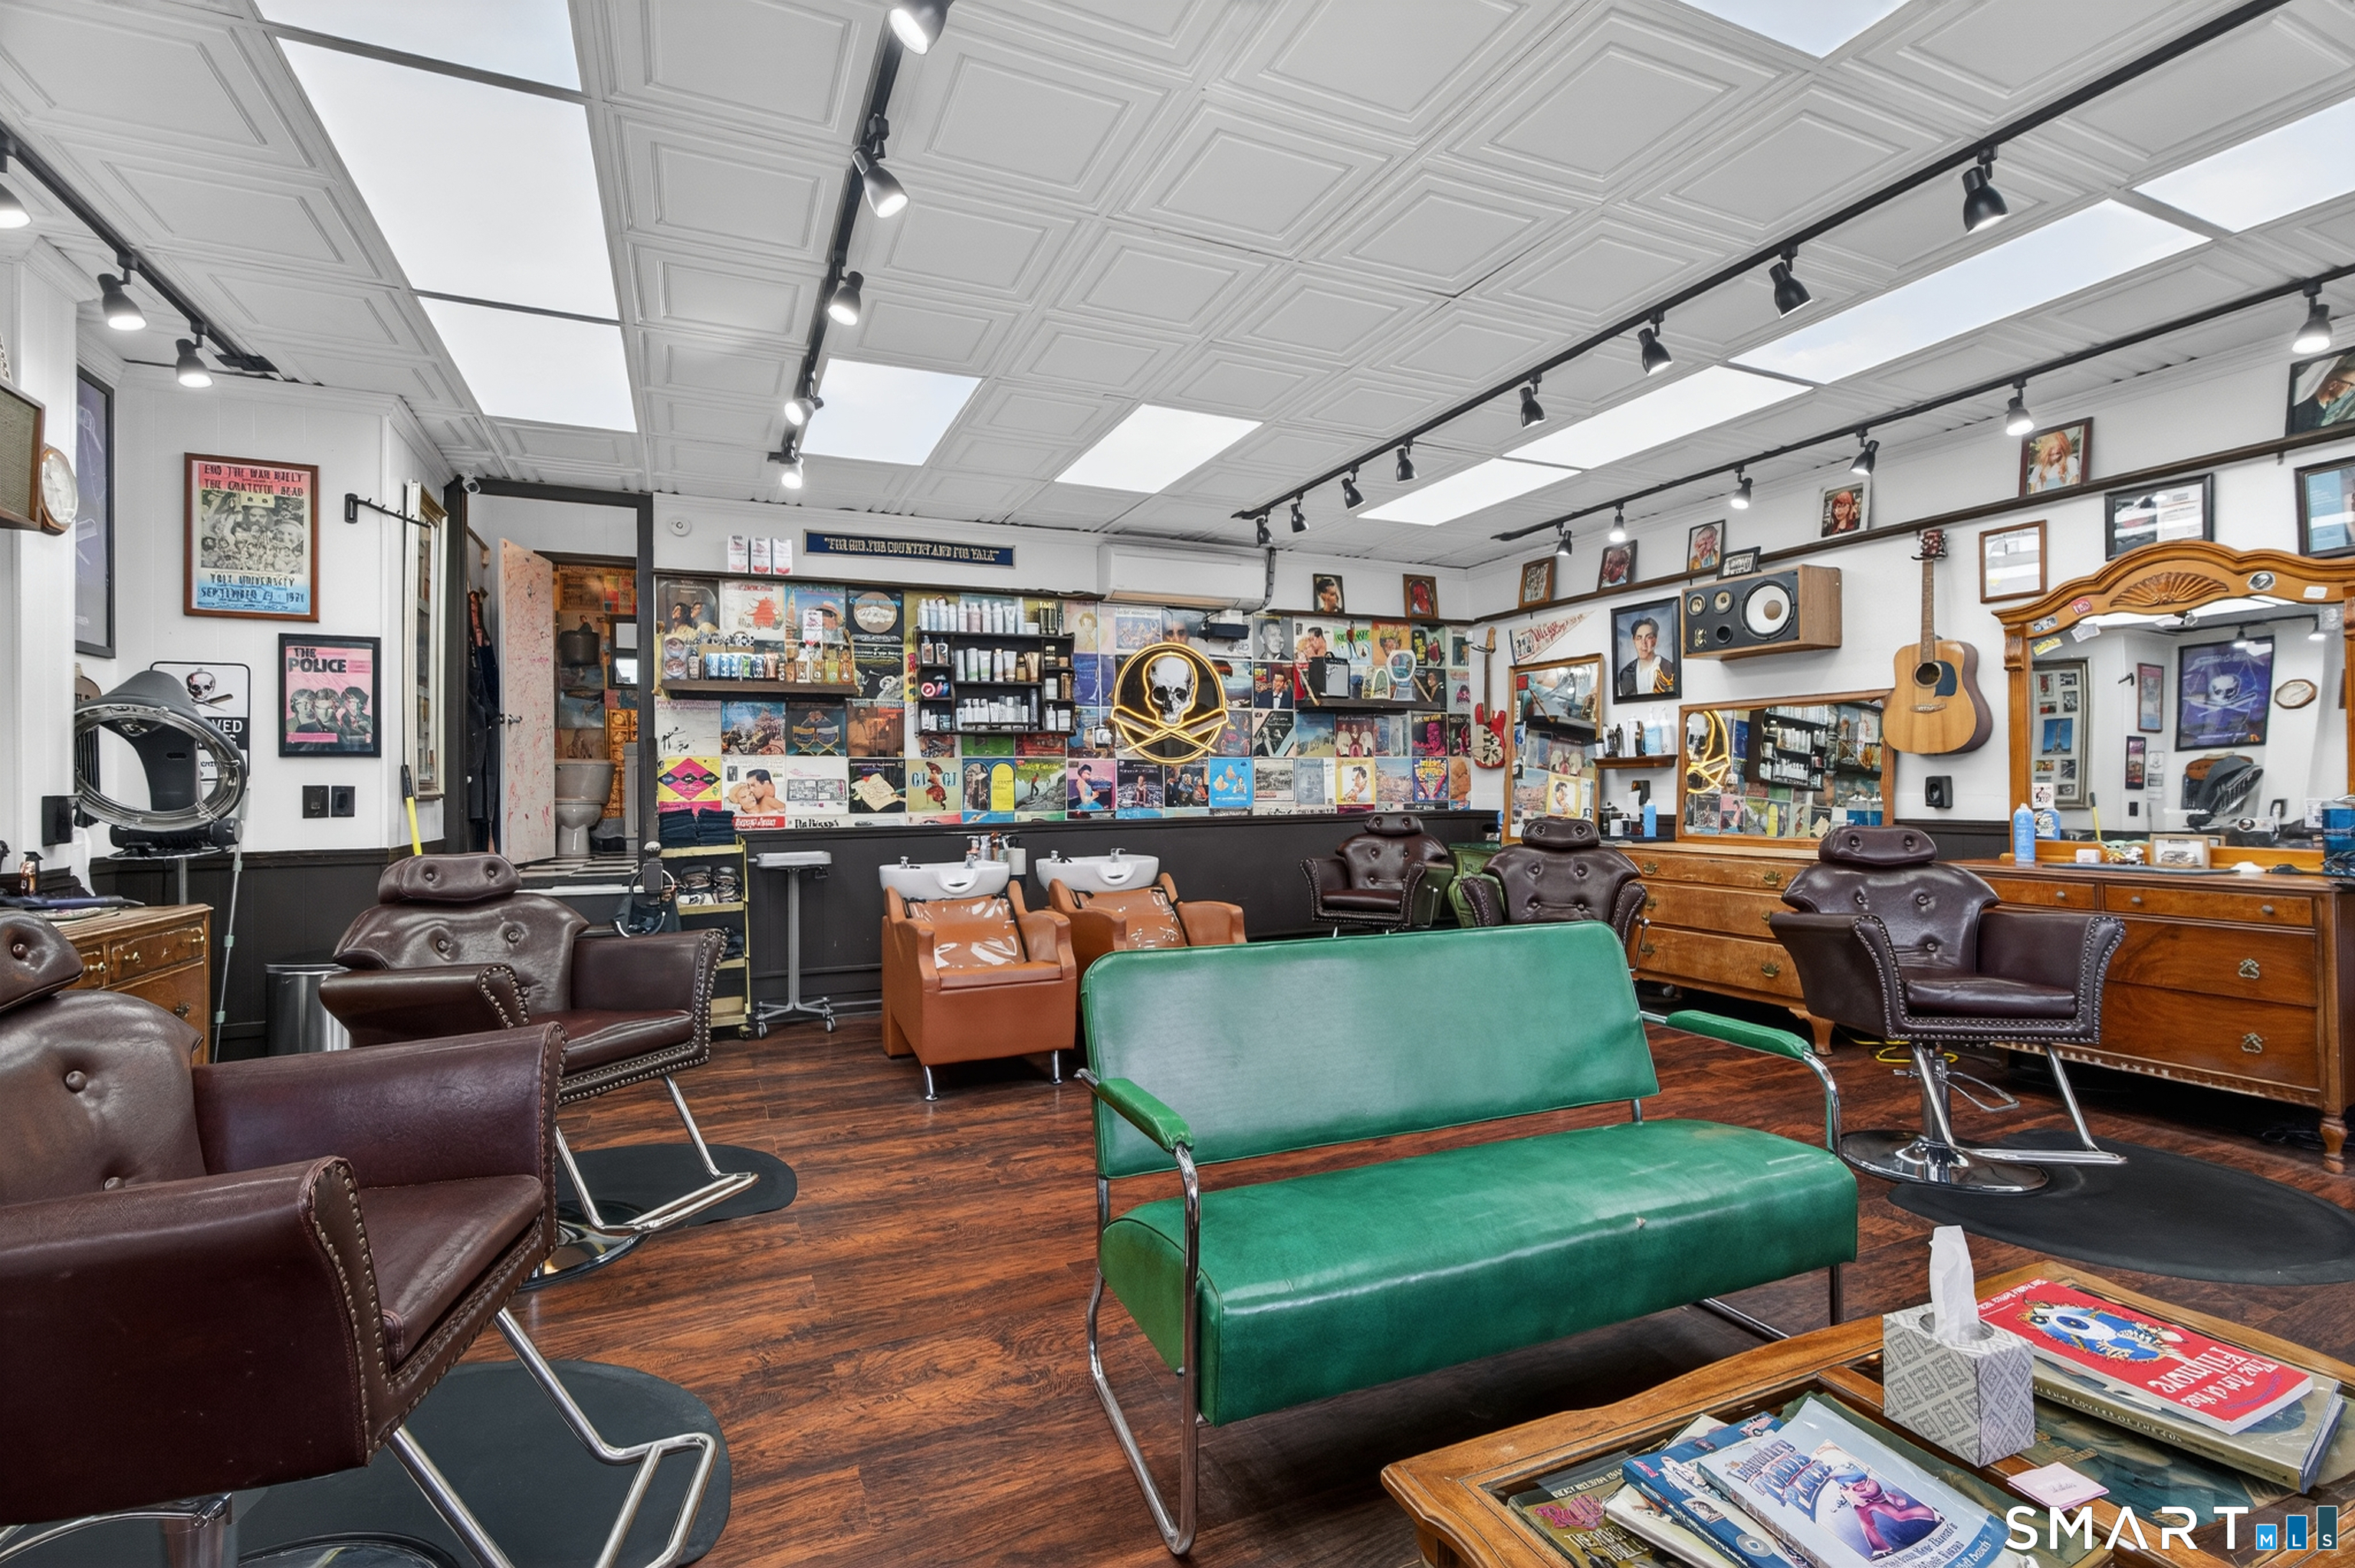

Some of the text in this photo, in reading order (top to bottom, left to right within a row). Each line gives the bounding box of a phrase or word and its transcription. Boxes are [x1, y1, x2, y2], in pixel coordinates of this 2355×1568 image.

[294, 648, 317, 658] THE
[287, 658, 347, 673] POLICE
[2146, 1347, 2248, 1394] Fillmore
